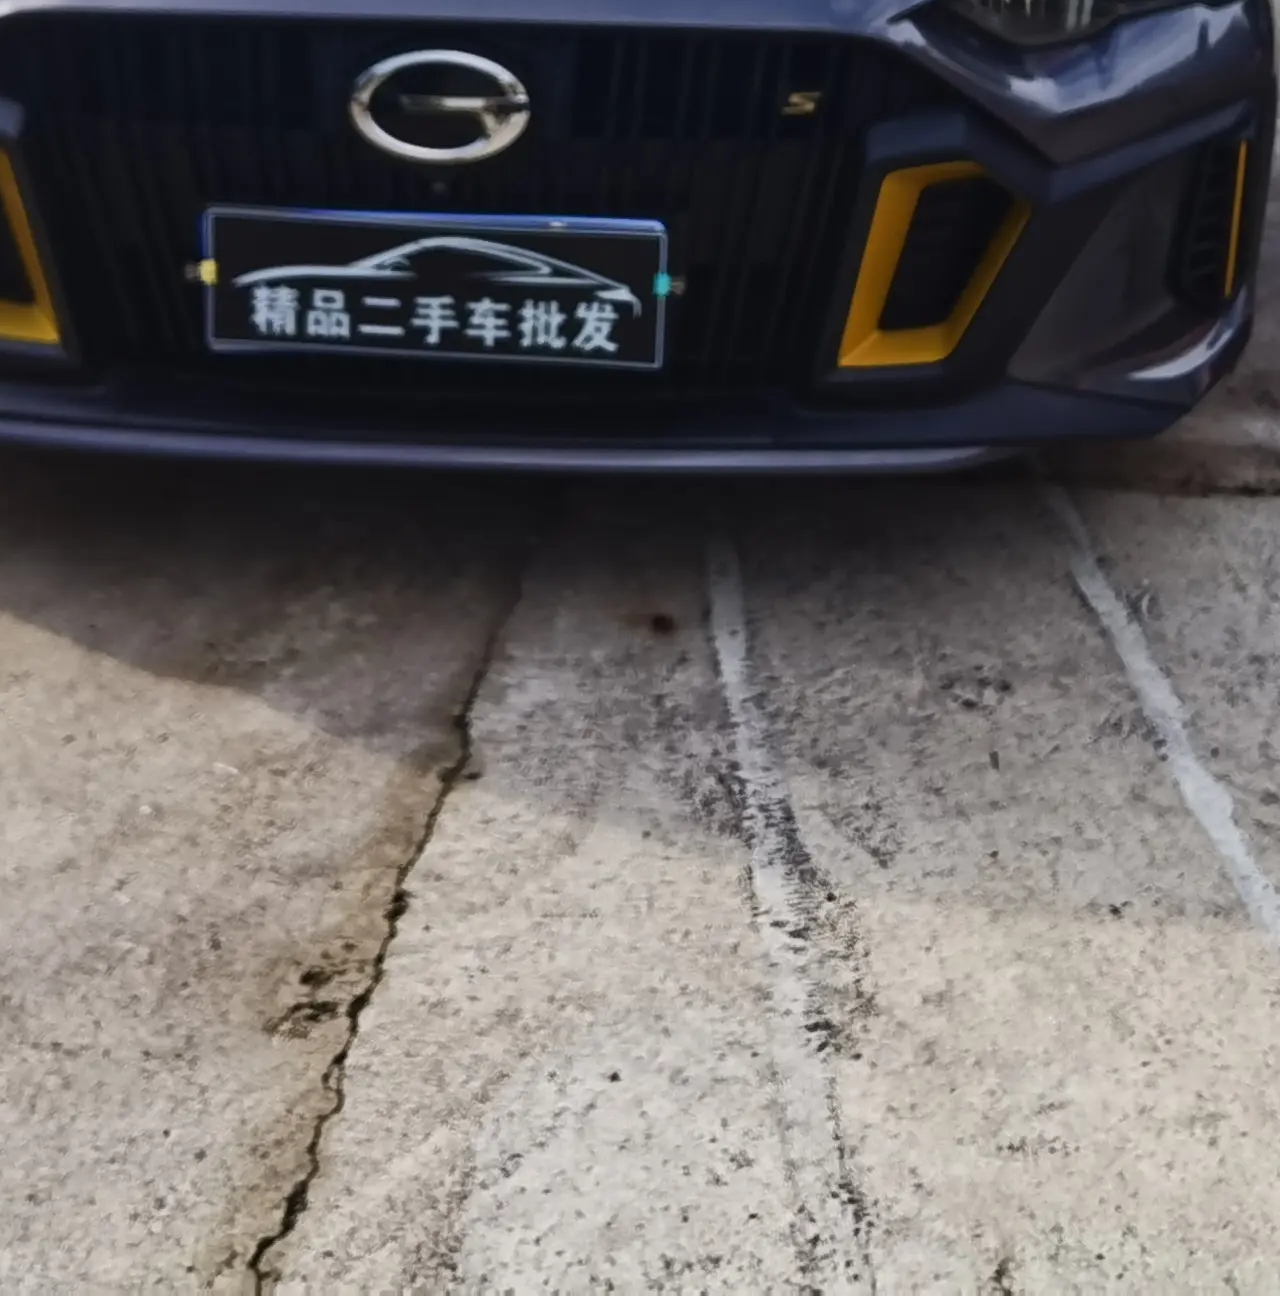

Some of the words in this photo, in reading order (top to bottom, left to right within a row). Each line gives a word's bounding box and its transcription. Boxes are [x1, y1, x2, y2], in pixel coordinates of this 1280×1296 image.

[250, 285, 619, 353] 精品二手车批发
